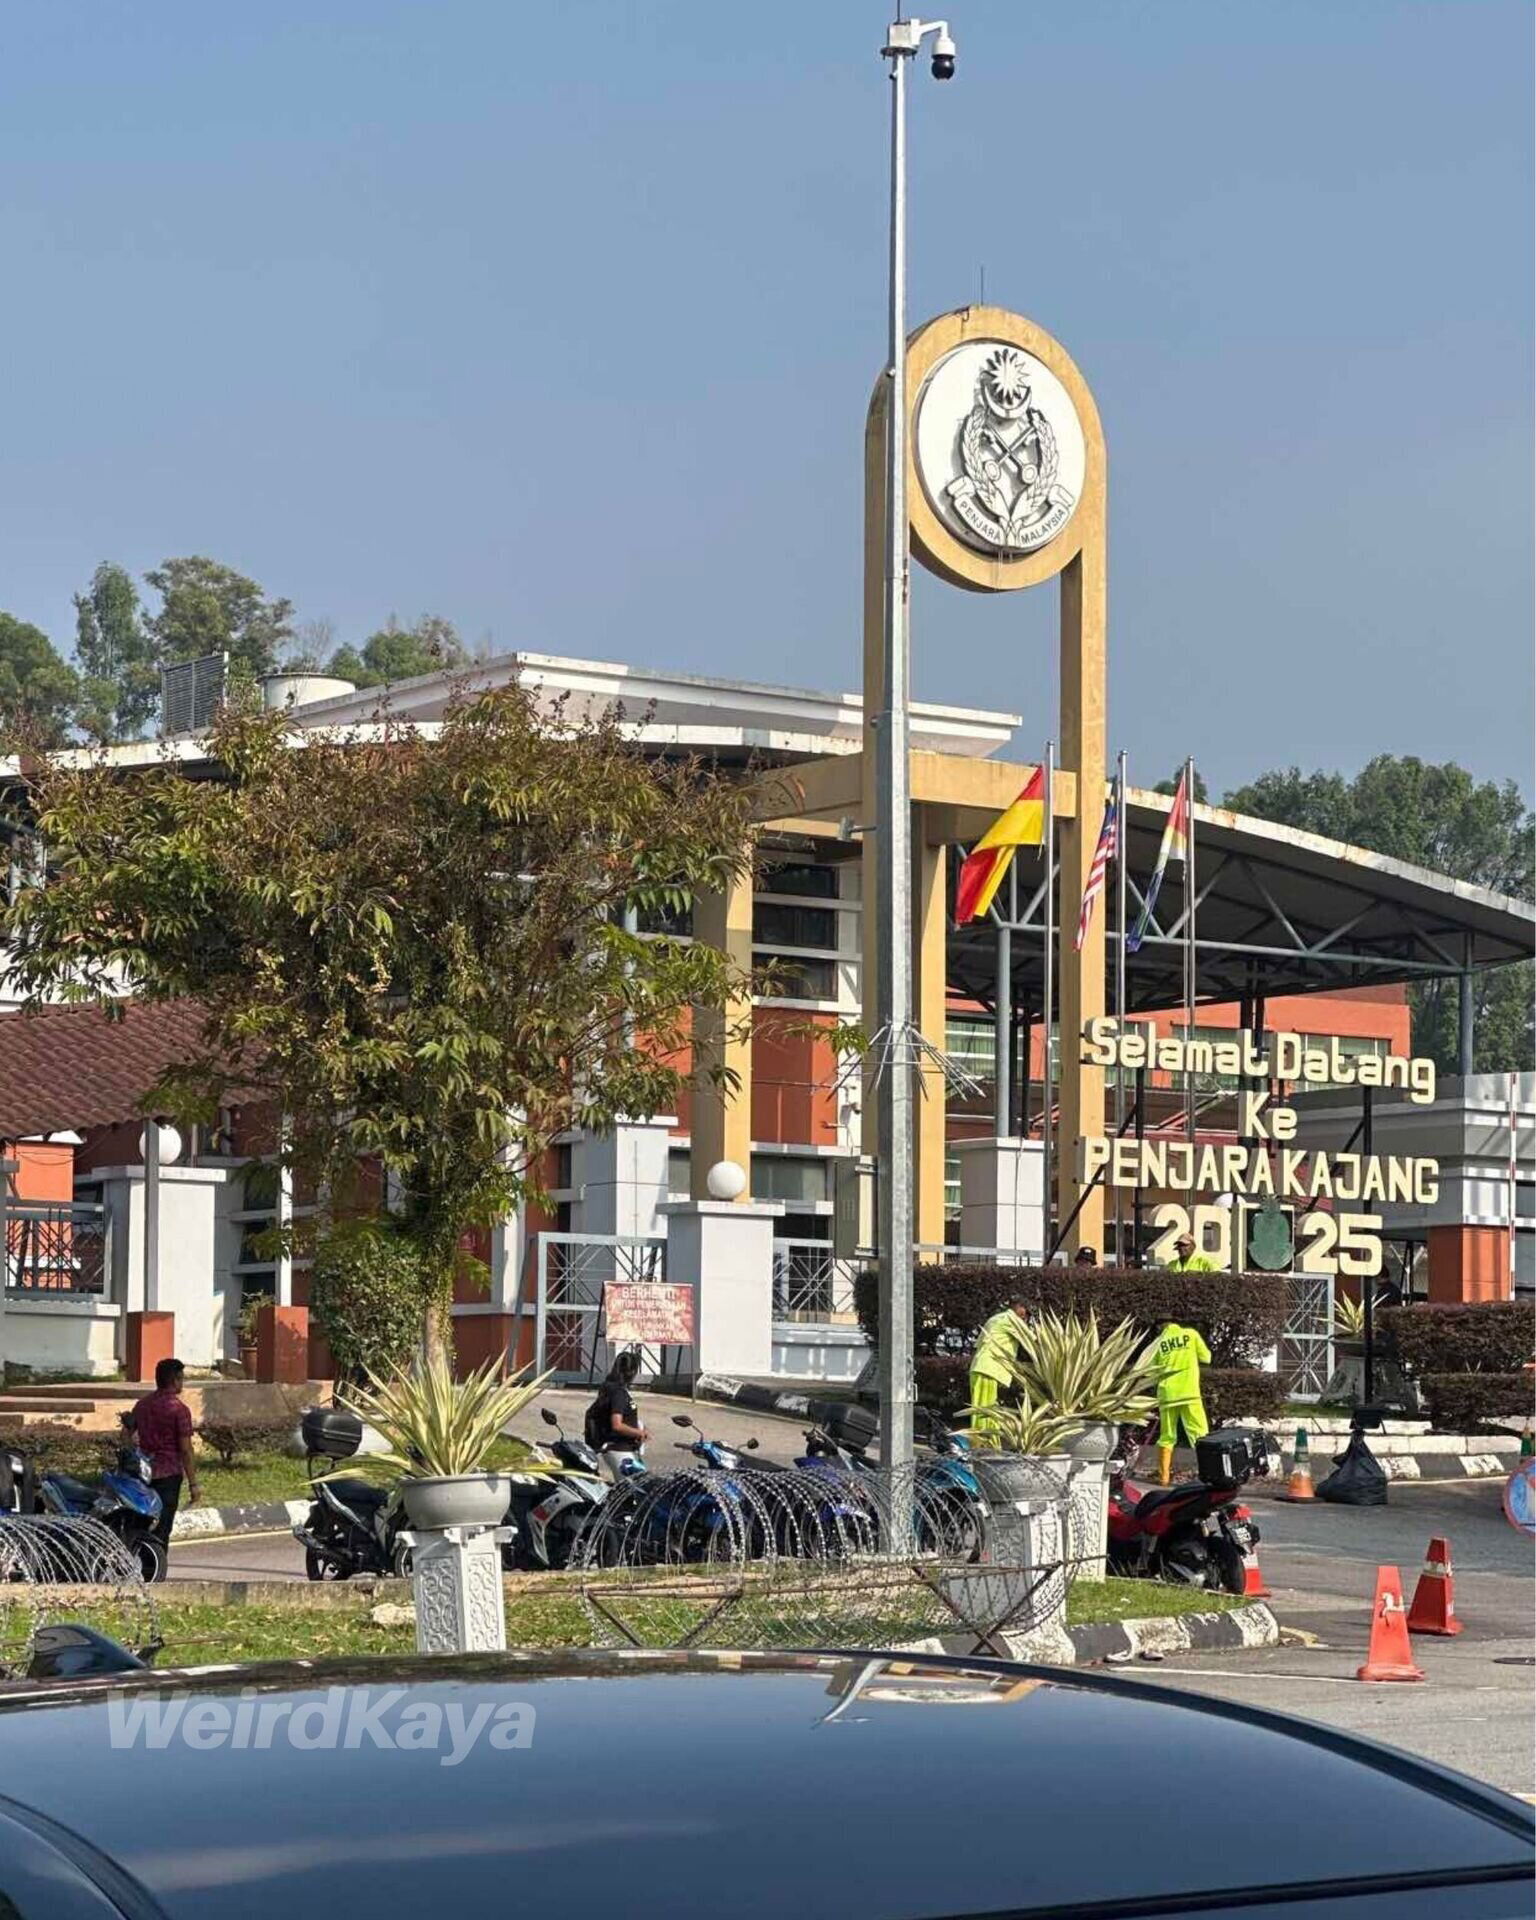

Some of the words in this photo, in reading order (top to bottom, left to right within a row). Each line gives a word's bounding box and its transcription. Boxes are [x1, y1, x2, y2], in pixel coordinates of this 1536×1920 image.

[959, 500, 1000, 541] PENJARA
[1020, 508, 1066, 544] MALAYSIA
[1088, 1016, 1269, 1076] Selamat
[1276, 1032, 1436, 1104] Datang
[1244, 1090, 1298, 1140] Ke
[1160, 1334, 1191, 1353] BKLP
